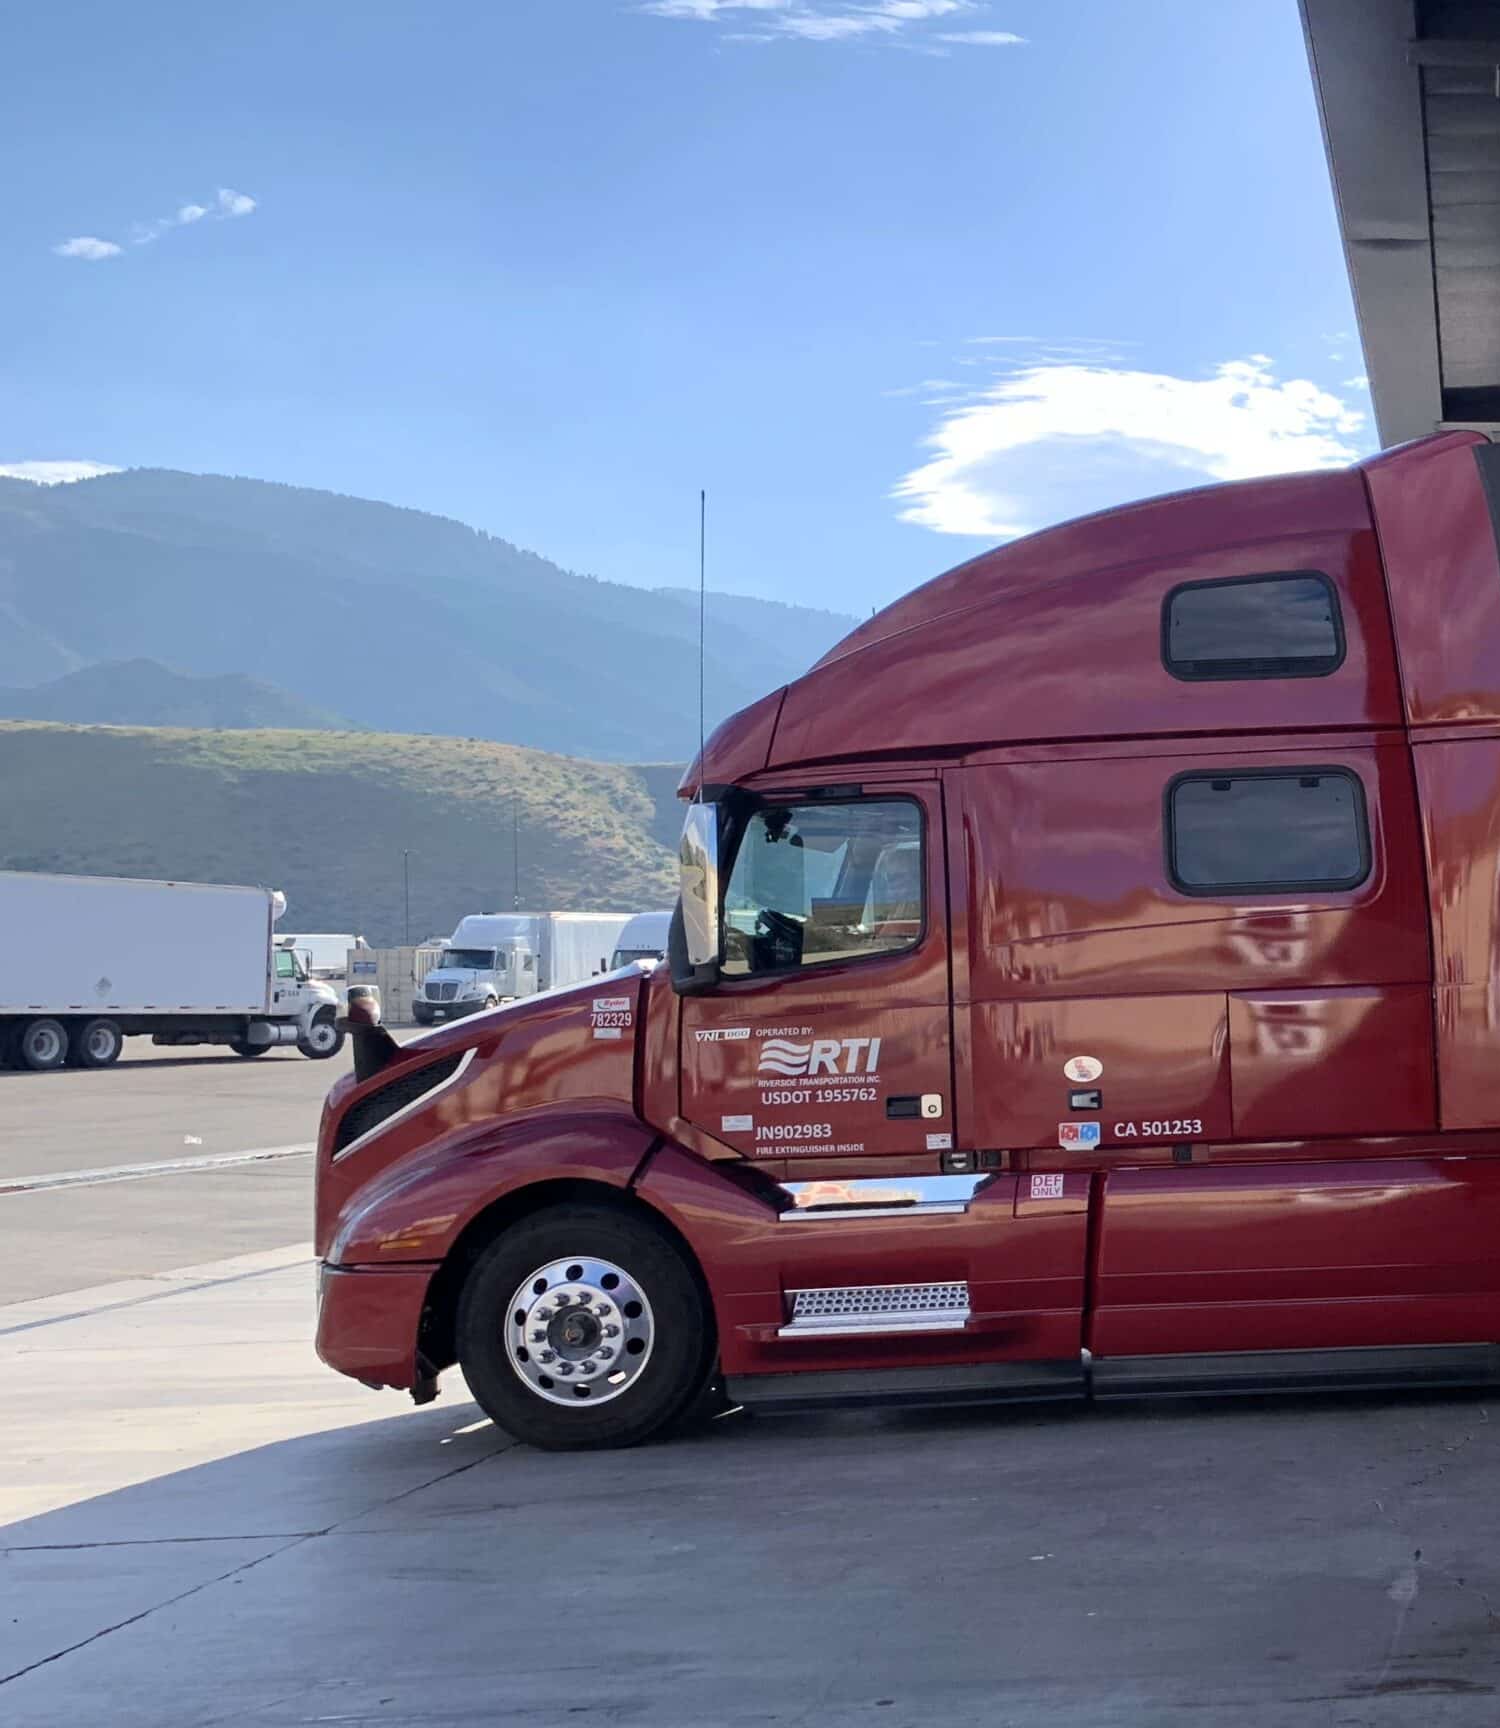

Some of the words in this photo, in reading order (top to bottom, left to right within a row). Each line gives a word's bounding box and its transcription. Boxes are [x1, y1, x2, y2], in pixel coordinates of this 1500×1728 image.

[590, 1012, 632, 1028] 782329
[755, 1028, 800, 1038] OPERATED
[807, 1037, 881, 1075] RTI
[758, 1079, 797, 1088] RIVERSIDE
[799, 1076, 866, 1087] TRANSPORTATION
[762, 1090, 812, 1105] USDOT
[816, 1088, 877, 1103] 1955762
[755, 1124, 832, 1141] JN902983
[1114, 1122, 1138, 1137] CA
[1142, 1119, 1202, 1136] 501253
[756, 1146, 774, 1155] FIRE
[775, 1144, 836, 1154] EXTINGUISHER
[837, 1143, 865, 1152] INSIDE
[1033, 1175, 1062, 1187] DEF
[1032, 1187, 1060, 1197] ONLY
